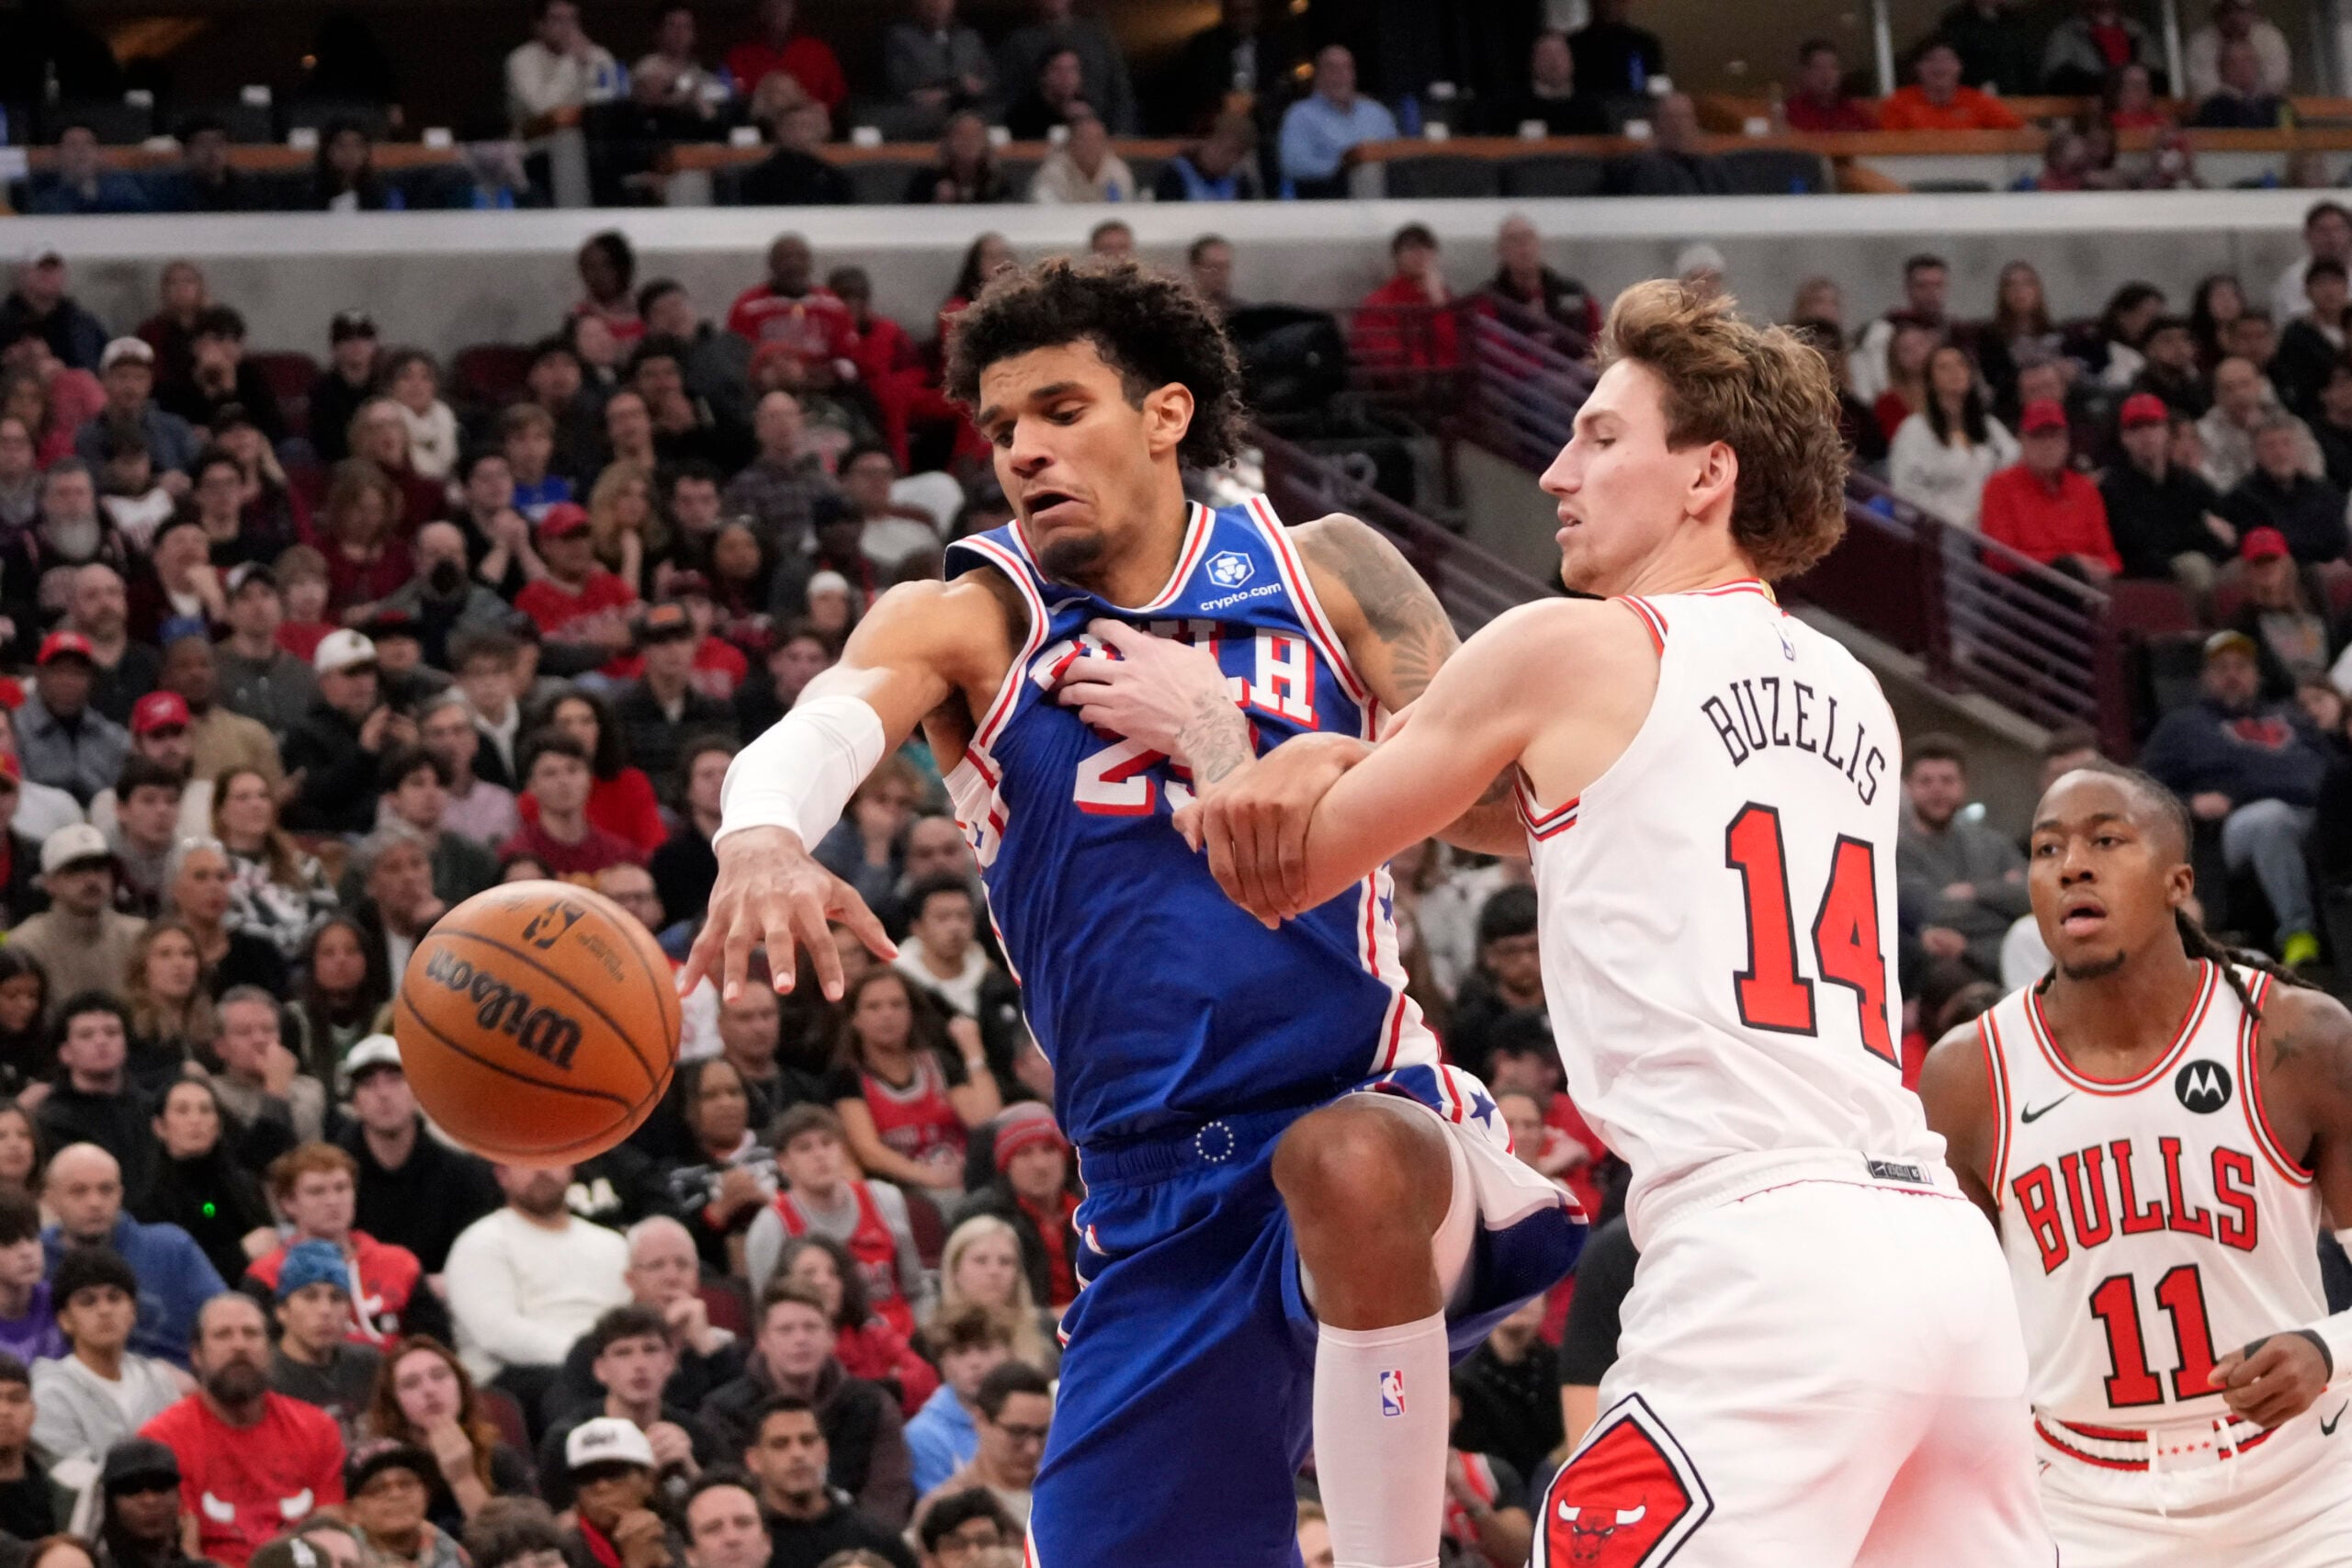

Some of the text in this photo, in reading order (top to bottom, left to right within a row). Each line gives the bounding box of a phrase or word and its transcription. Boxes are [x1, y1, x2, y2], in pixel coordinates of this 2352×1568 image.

[1200, 582, 1282, 612] crypto.com
[1701, 677, 1886, 806] BUZELIS
[1725, 801, 1902, 1070] 14
[425, 946, 582, 1071] Wilson
[2011, 1136, 2258, 1276] BULLS
[2089, 1263, 2228, 1408] 11
